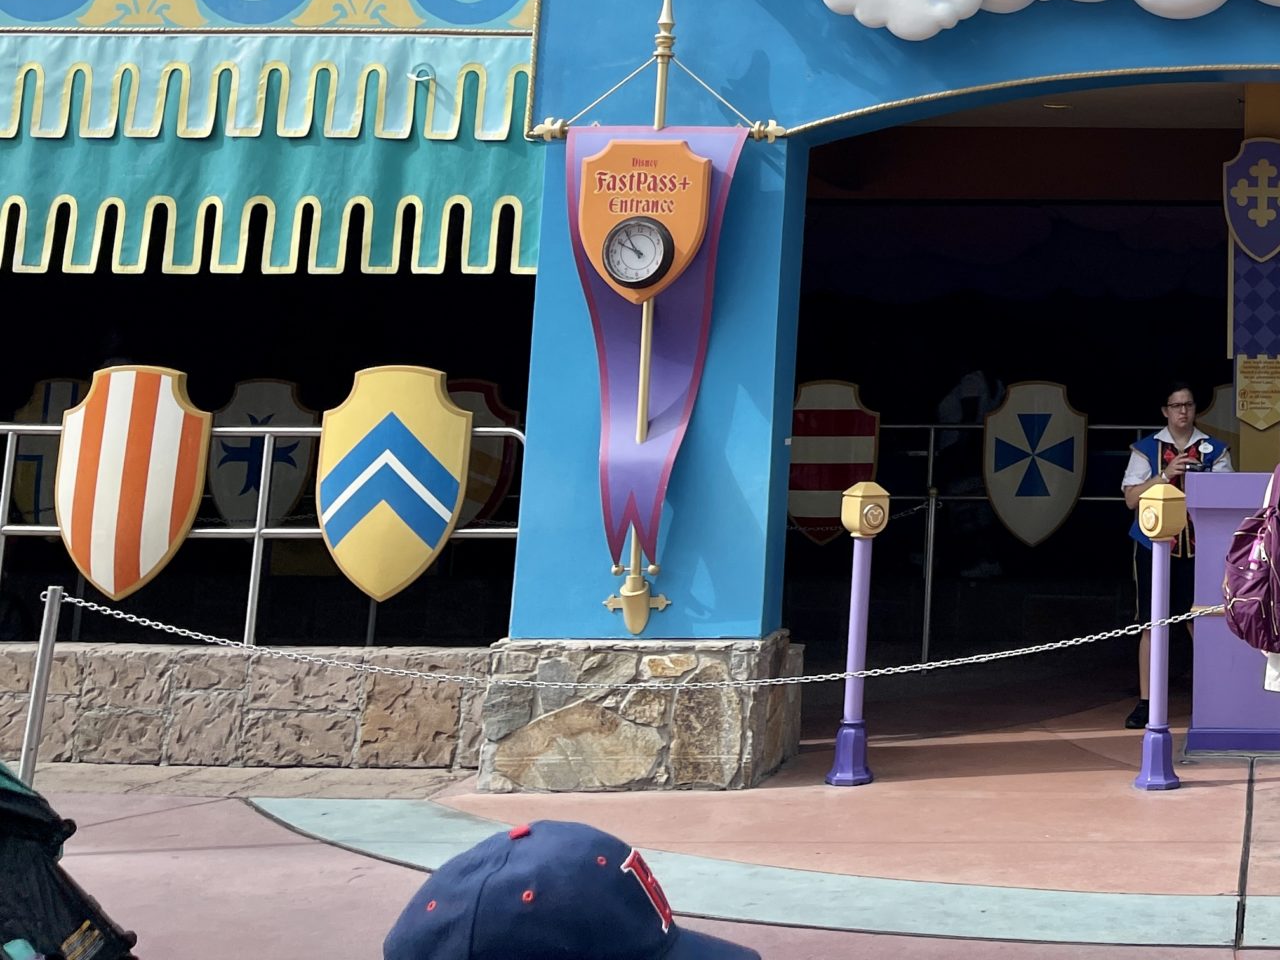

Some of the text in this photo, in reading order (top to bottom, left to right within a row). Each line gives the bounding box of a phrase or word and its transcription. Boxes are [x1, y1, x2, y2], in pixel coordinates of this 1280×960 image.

[632, 157, 658, 168] Disney
[595, 171, 691, 193] FastPass+
[608, 197, 675, 214] Entrance
